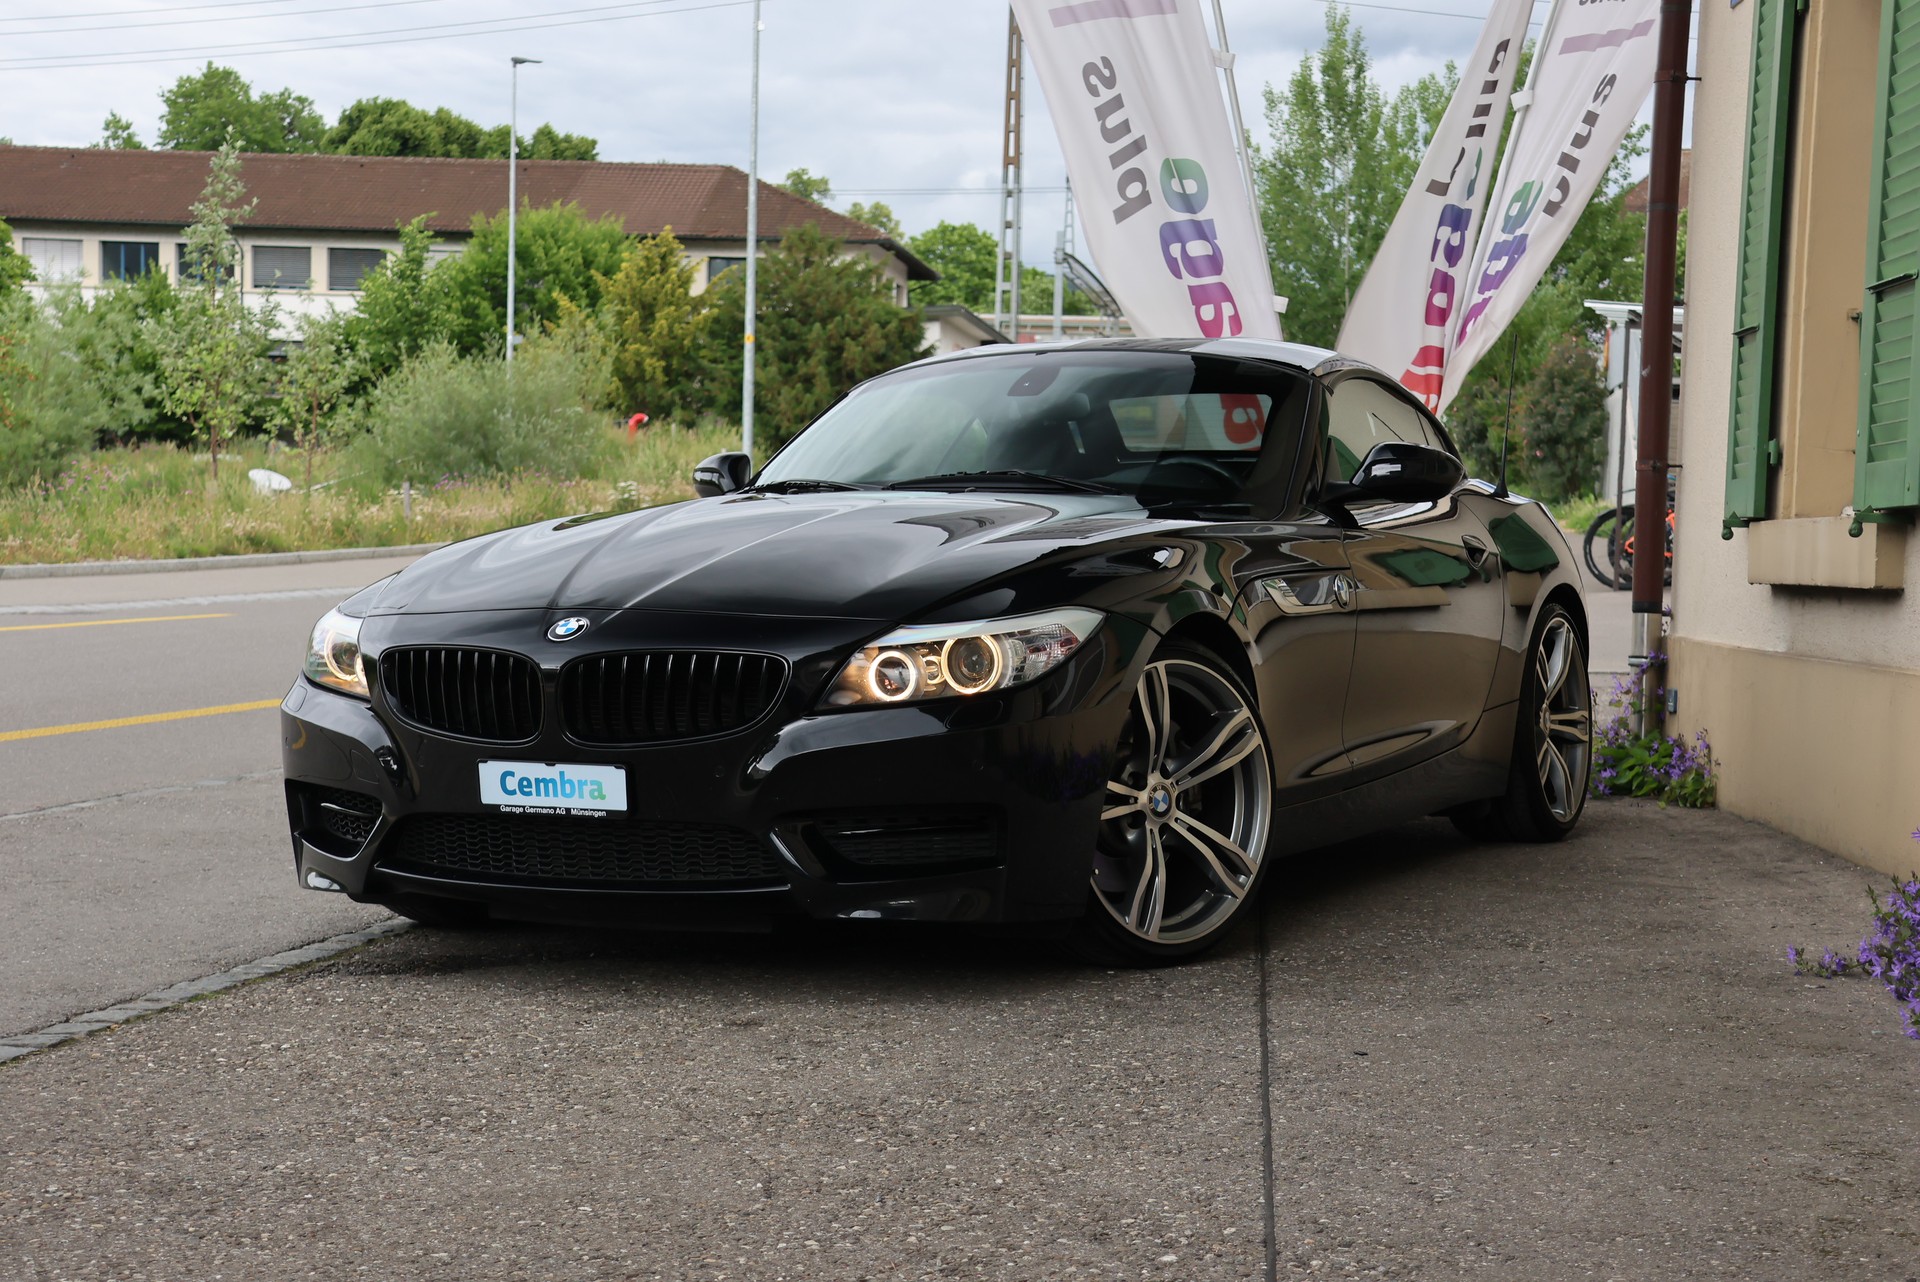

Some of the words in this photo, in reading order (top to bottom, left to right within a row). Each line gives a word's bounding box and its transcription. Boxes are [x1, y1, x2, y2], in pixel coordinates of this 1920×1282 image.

[500, 770, 606, 800] Cembra
[500, 804, 524, 814] Garage
[524, 806, 555, 815] Germano
[570, 808, 607, 818] Münsingen
